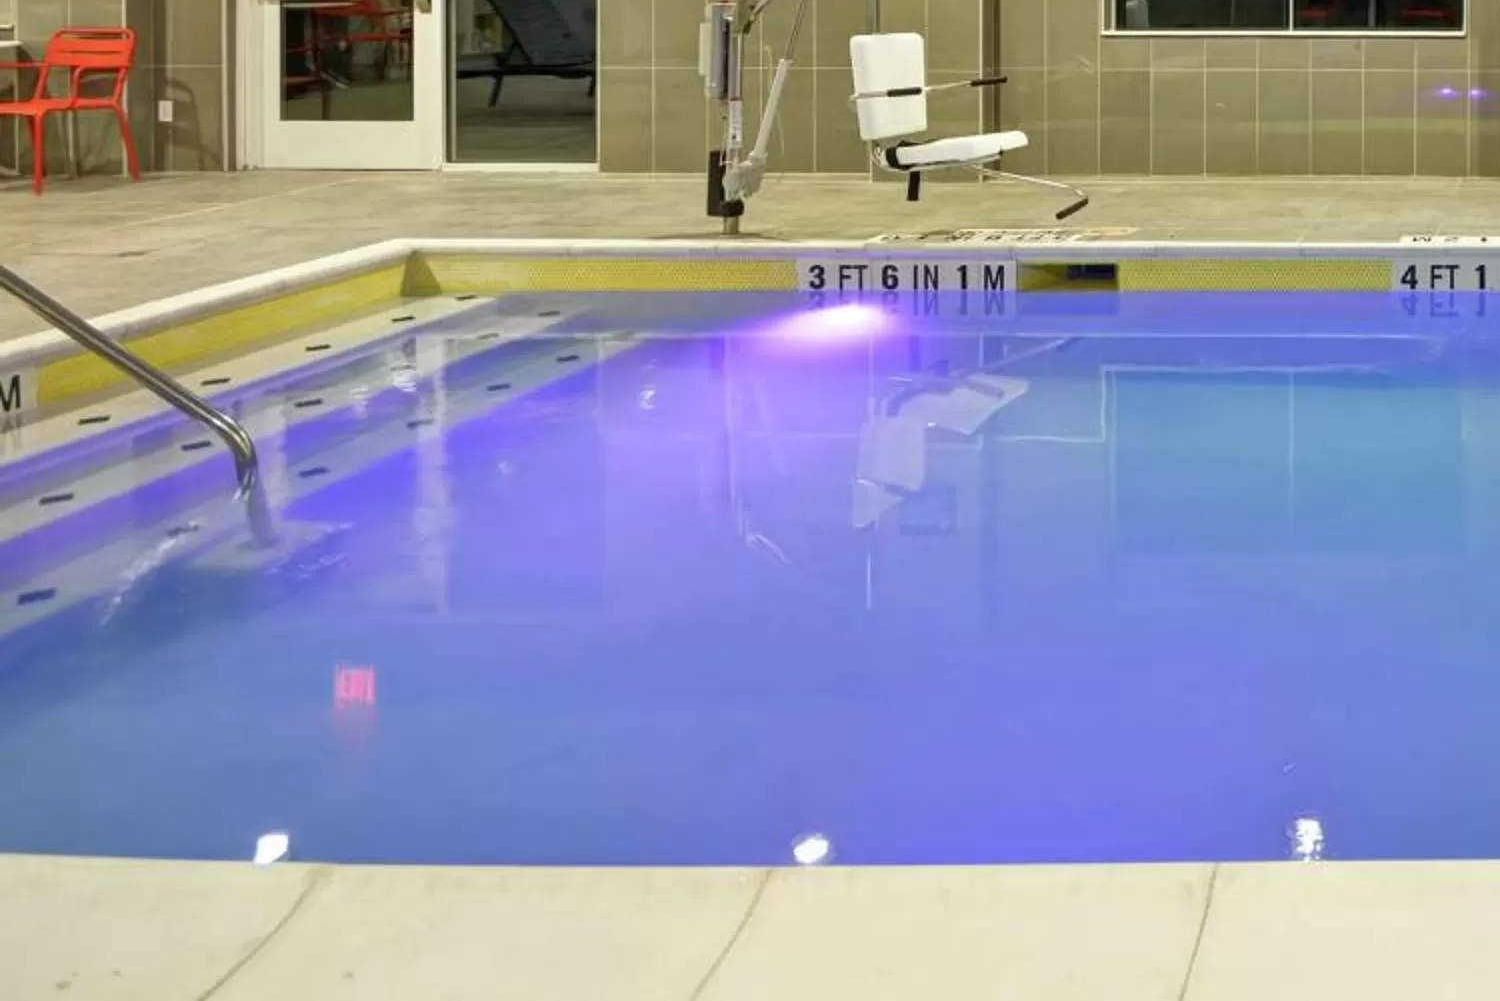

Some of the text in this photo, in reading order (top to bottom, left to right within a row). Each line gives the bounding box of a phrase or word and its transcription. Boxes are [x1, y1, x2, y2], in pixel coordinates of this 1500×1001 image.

[809, 264, 1005, 291] 3 FT 6 IN 1 M
[1400, 264, 1418, 290] 4
[1430, 264, 1460, 290] FT
